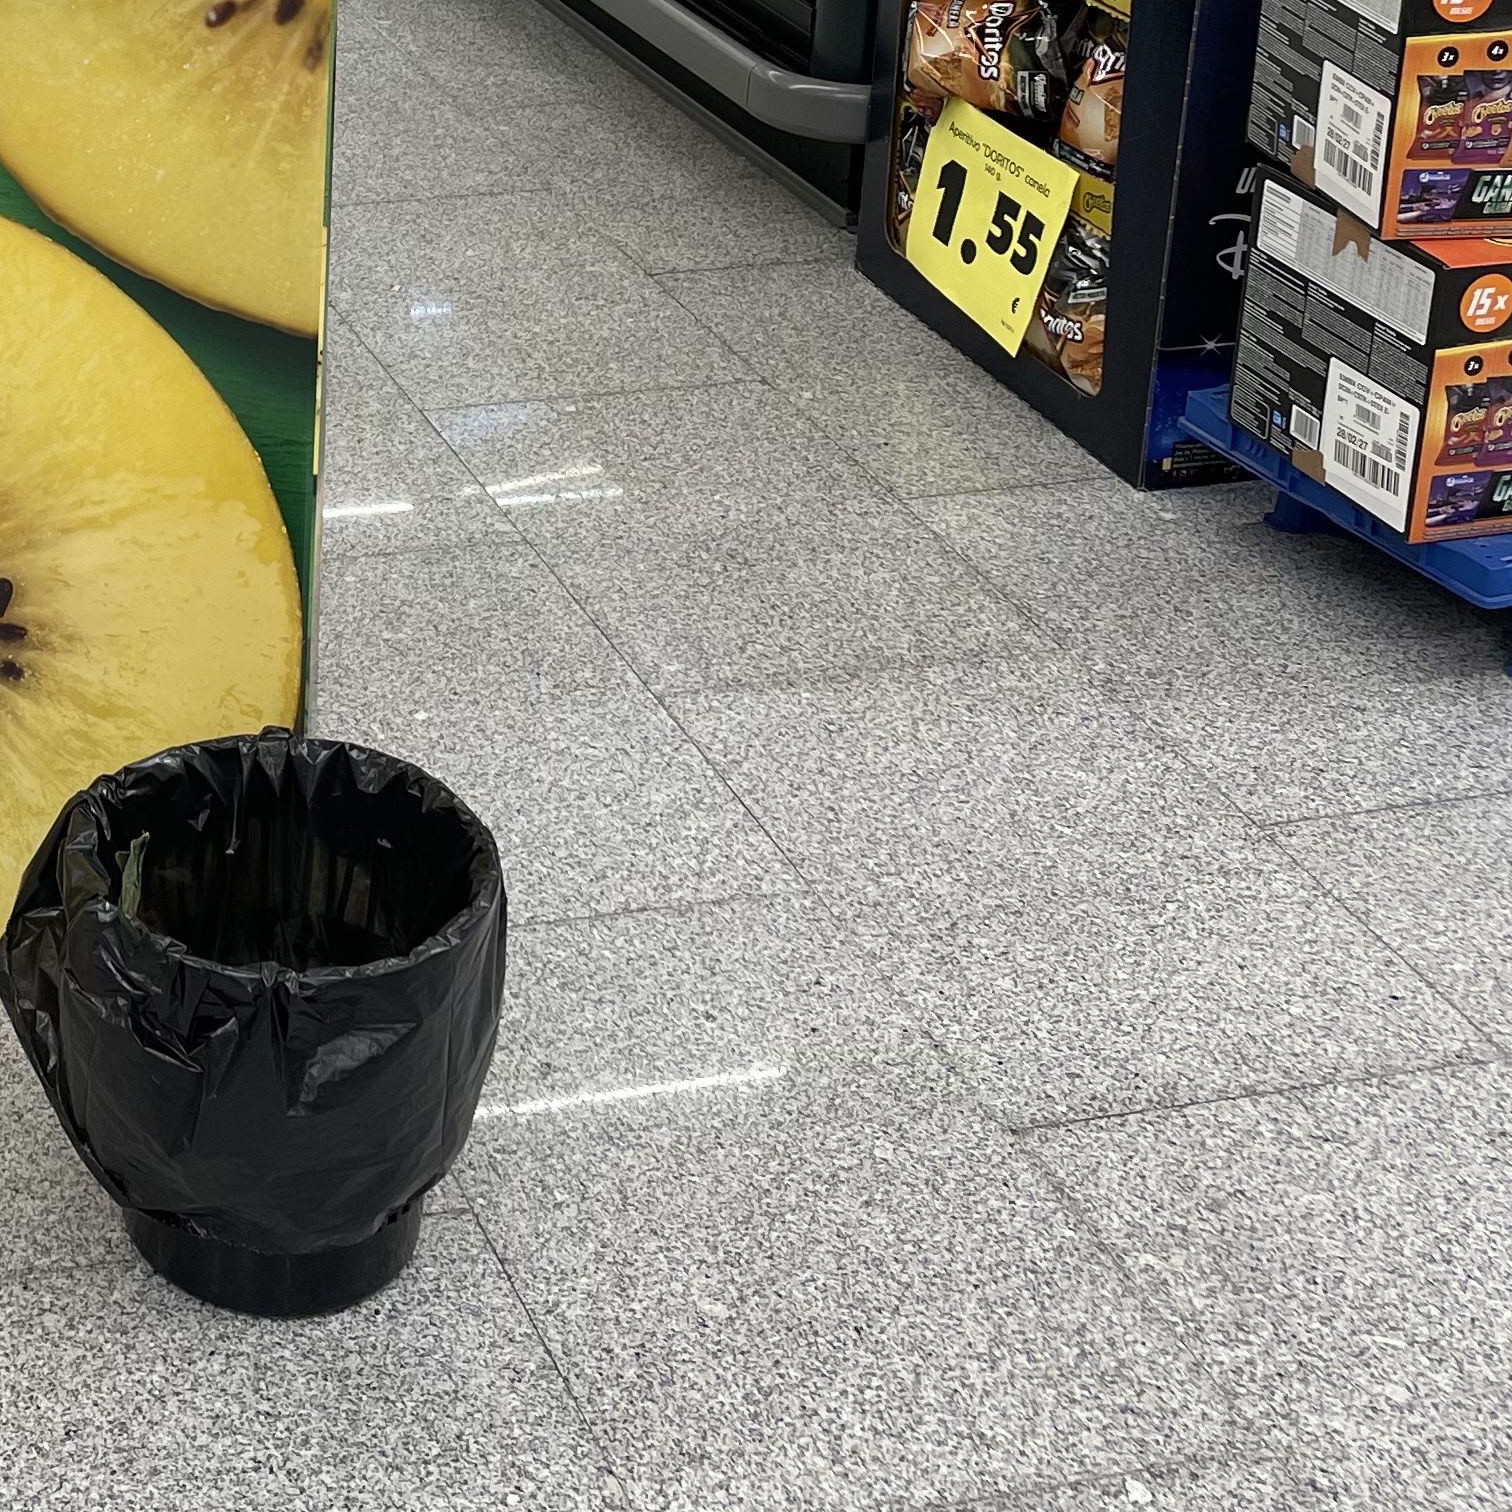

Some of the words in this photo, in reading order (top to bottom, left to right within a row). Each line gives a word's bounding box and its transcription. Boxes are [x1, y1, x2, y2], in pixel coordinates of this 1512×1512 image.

[978, 1, 1015, 81] Doritos
[949, 120, 981, 151] Aperitivo
[982, 143, 1025, 178] "DORITOS"
[1024, 173, 1051, 198] canela
[932, 159, 1046, 276] 1.55
[1011, 297, 1021, 315] €
[1039, 307, 1084, 343] ritos
[1466, 287, 1509, 317] 15x
